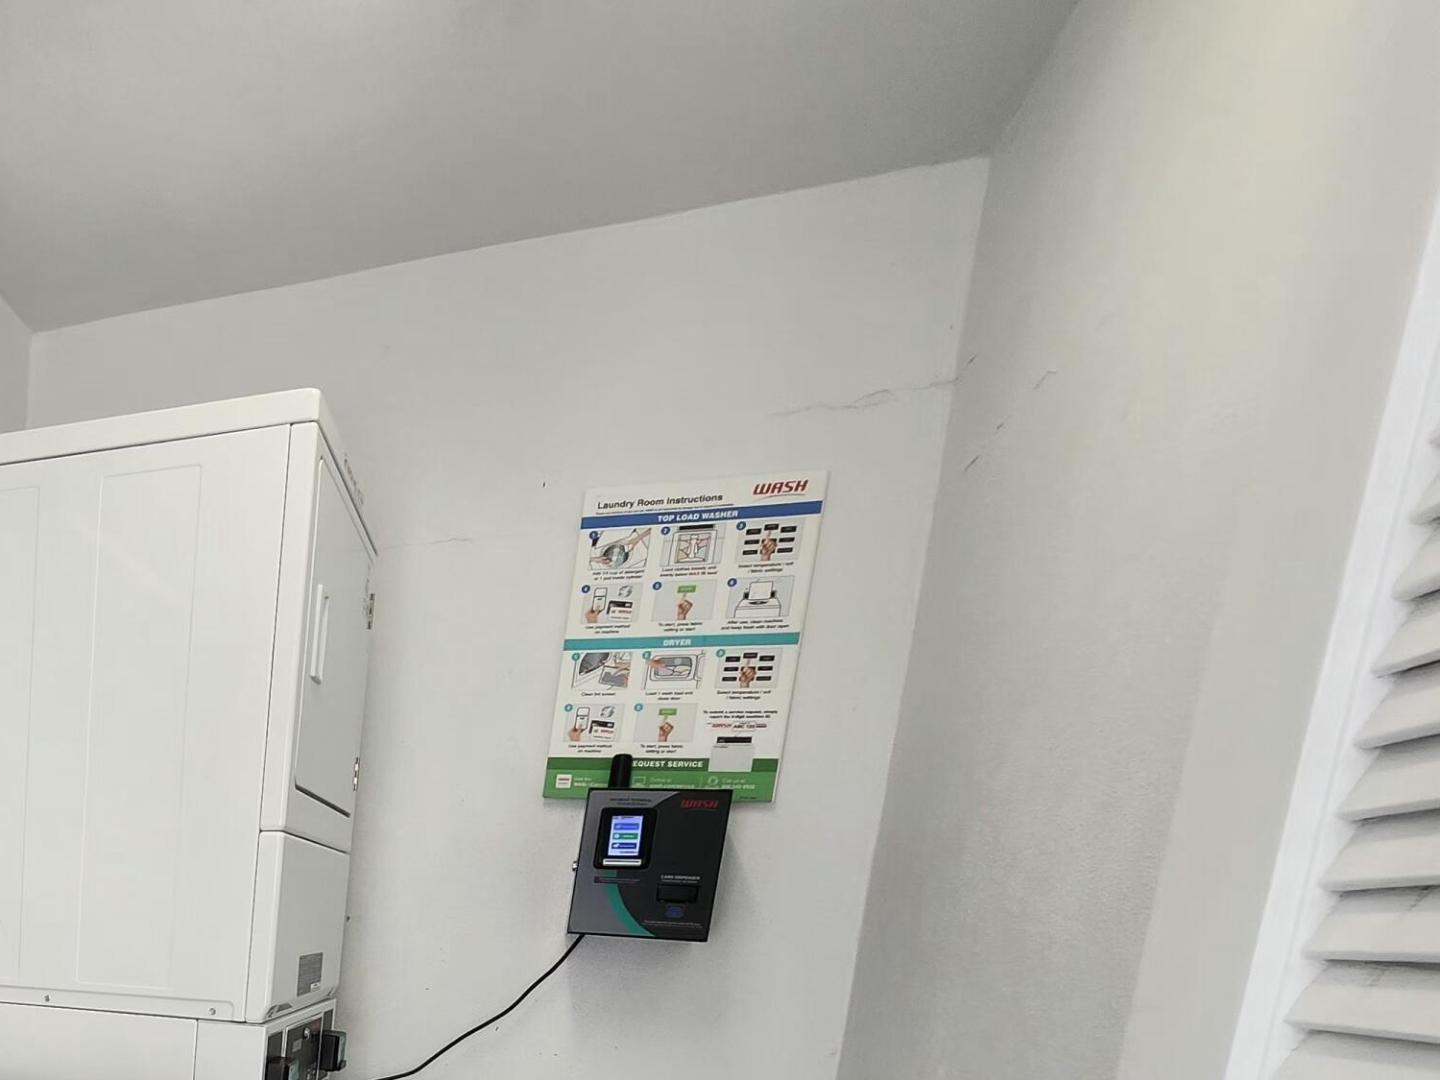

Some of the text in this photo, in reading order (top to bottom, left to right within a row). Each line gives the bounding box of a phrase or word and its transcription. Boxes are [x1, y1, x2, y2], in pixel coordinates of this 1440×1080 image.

[752, 479, 809, 496] WASH
[597, 499, 635, 510] Laundry
[637, 498, 664, 507] Room
[666, 493, 723, 504] Instructions
[657, 510, 739, 523] TOP LOAD WASHER
[662, 638, 691, 647] DRYER
[631, 760, 703, 768] EQUEST SERVICE
